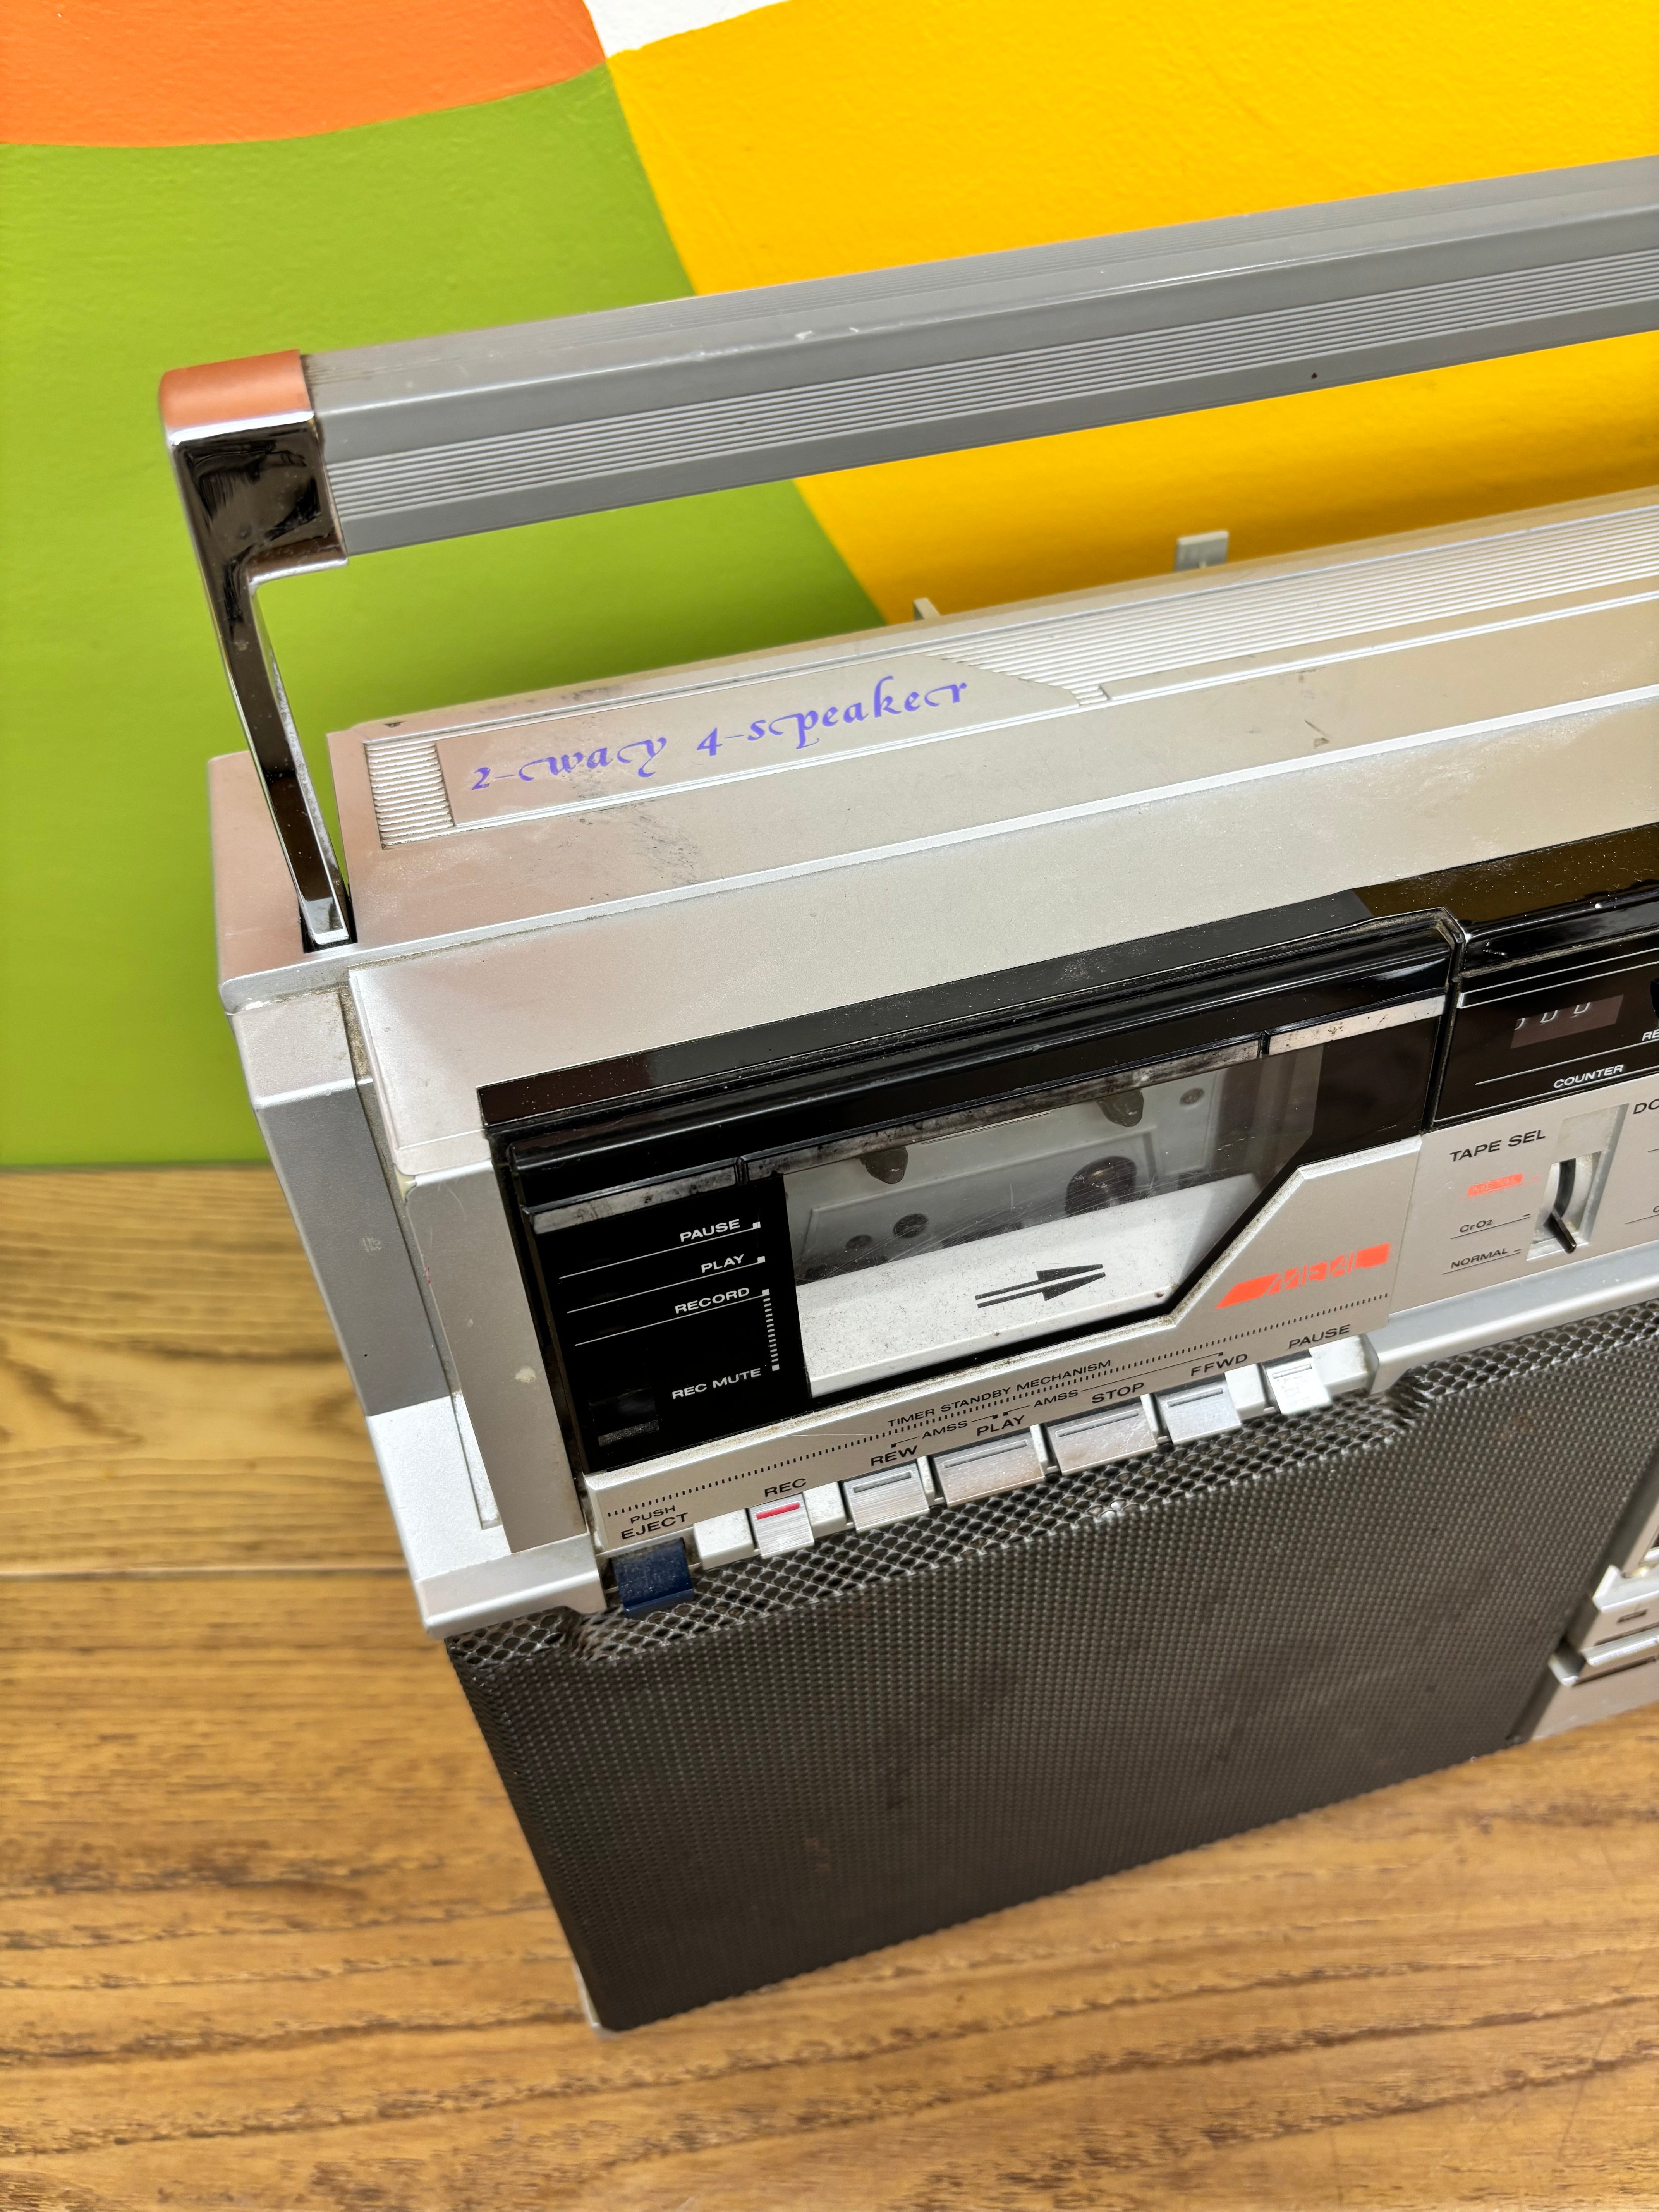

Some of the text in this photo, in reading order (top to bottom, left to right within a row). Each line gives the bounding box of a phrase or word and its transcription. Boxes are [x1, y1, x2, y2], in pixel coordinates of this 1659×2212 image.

[471, 675, 968, 790] 2-way 4-speaker
[1553, 1064, 1624, 1089] COUNTER
[1449, 1129, 1546, 1162] TAPE SEL
[679, 1218, 741, 1242] PAUSE
[1459, 1219, 1492, 1233] CrO2
[701, 1254, 745, 1273] PLAY
[1450, 1248, 1508, 1269] NORMAL
[674, 1286, 750, 1314] RECORD
[1288, 1324, 1351, 1350] PAUSE
[1190, 1353, 1248, 1377] FFWD
[672, 1367, 762, 1400] REC MUTE
[887, 1359, 1111, 1427] TIMER STANDBY MECHANISM
[1091, 1381, 1145, 1404] STOP
[1033, 1389, 1079, 1408] AMSS
[921, 1420, 968, 1439] AMSS
[976, 1415, 1026, 1436] PLAY
[870, 1444, 918, 1467] REW
[764, 1477, 807, 1498] REC
[620, 1511, 690, 1540] EJECT
[629, 1504, 677, 1525] PUSH
